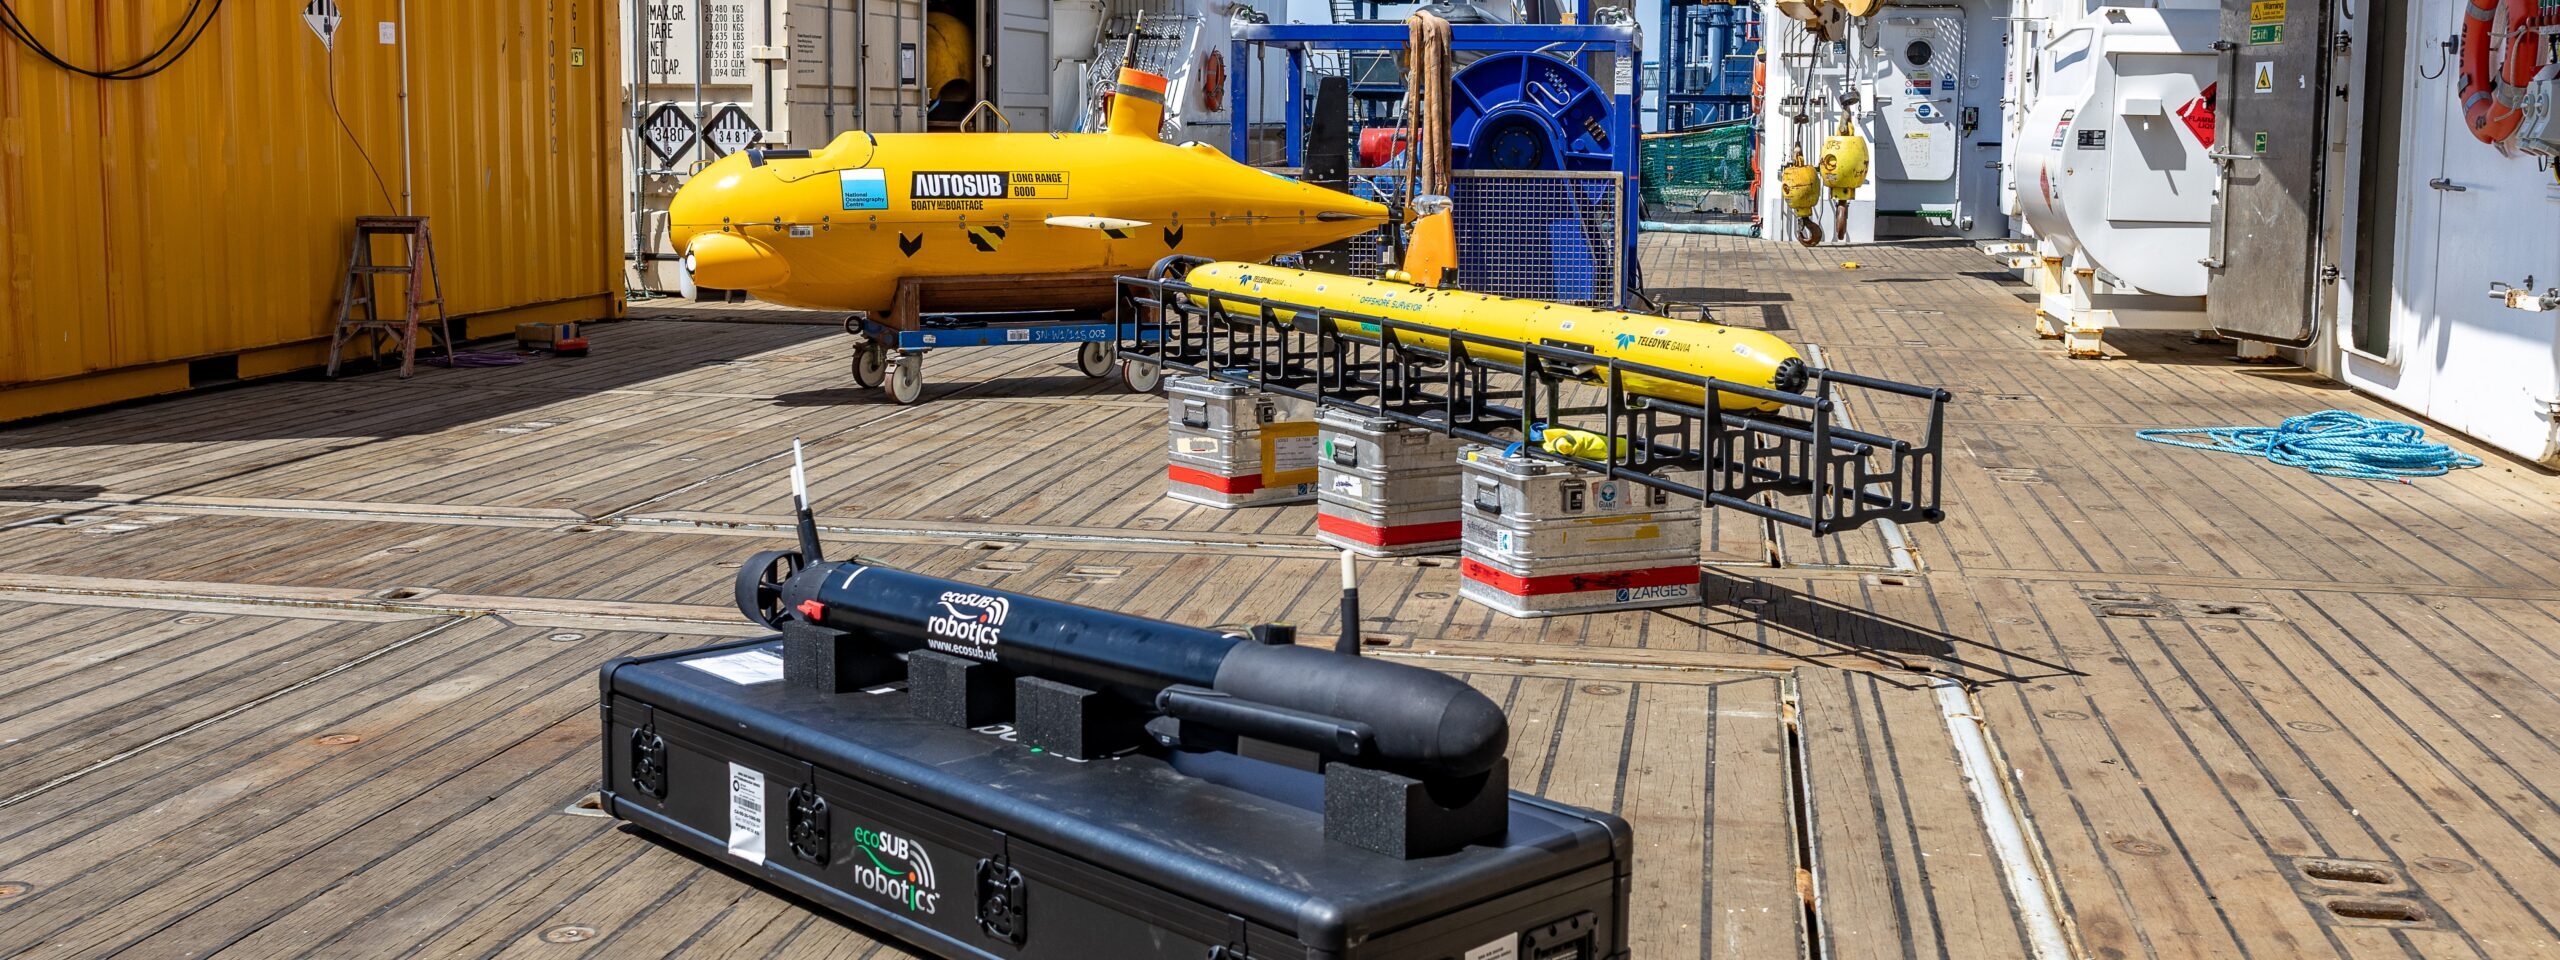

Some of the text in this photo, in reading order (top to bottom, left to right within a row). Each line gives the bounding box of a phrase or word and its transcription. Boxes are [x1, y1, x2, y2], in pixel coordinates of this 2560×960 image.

[649, 4, 686, 21] MAX.GR.
[705, 5, 744, 13] 30.480 KGS
[705, 14, 745, 22] 67.200 LBS
[650, 22, 673, 39] TARE
[709, 23, 745, 31] 3.010 KGS
[709, 32, 745, 40] 6.635 LBS
[2251, 29, 2268, 41] Exit
[650, 40, 664, 57] NET
[705, 41, 745, 49] 27.470 KGS
[705, 50, 745, 58] 60.565 LBS
[714, 59, 728, 68] 31.0
[710, 68, 728, 77] 1.094
[2189, 115, 2216, 123] FLAMM
[2198, 121, 2216, 130] LIQU
[655, 127, 685, 142] 3480
[667, 146, 673, 156] 9
[1012, 173, 1062, 183] LONG RANGE
[915, 173, 1002, 197] AUTOSUB
[1014, 186, 1036, 197] 6000
[911, 200, 936, 211] BOATY
[1359, 296, 1423, 312] OFFSHORE SURVEYOR
[1637, 335, 1691, 353] TELEDYNE GAVIA
[1598, 500, 1616, 509] GIANT
[1632, 584, 1688, 600] ZARGES
[940, 591, 994, 608] ecoSUB
[927, 613, 1000, 646] robotics
[927, 638, 999, 662] www.ecosub.uk
[854, 826, 909, 860] ecoSUB
[854, 864, 936, 915] robotics
